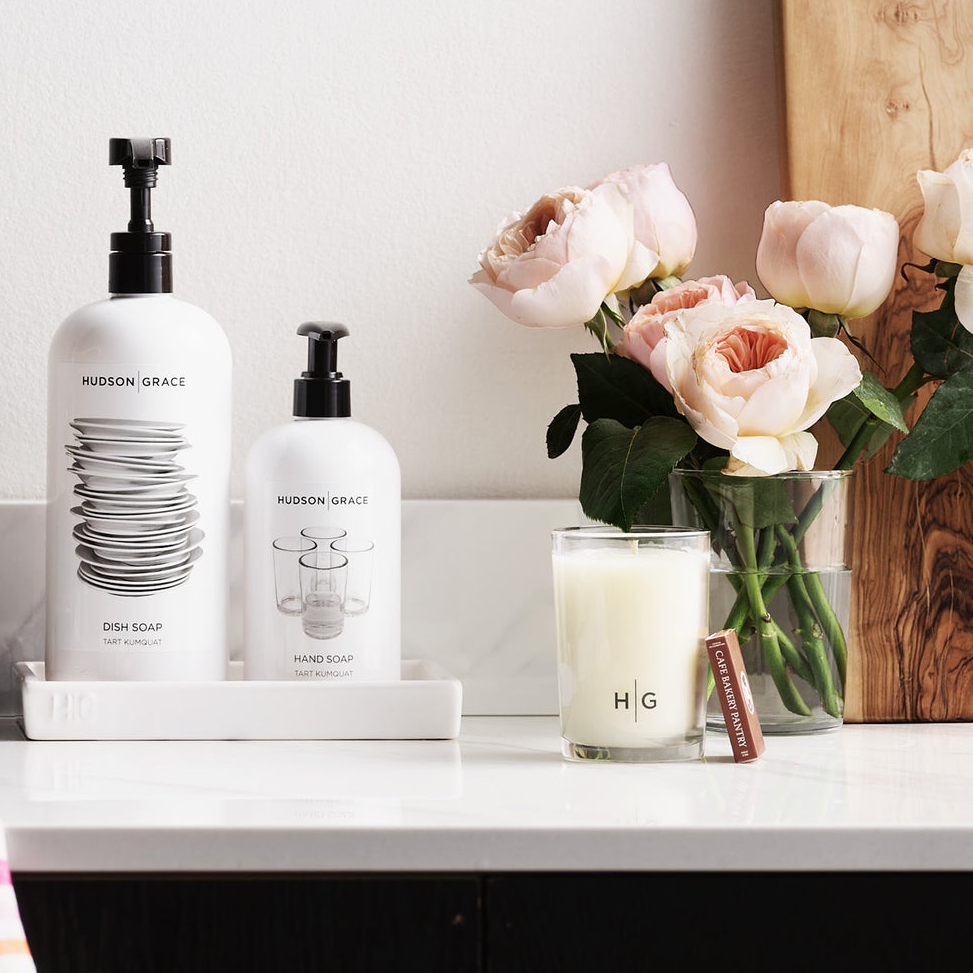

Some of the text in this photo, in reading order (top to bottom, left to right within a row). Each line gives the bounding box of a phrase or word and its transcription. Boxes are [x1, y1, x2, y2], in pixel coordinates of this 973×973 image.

[82, 376, 186, 388] HUDSON GRACE
[277, 495, 369, 506] HUDSON GRACE
[103, 622, 163, 632] DISH SOAP
[123, 638, 162, 646] KUMQUAT
[294, 654, 354, 664] HAND SOAP
[714, 650, 729, 676] CAFE
[294, 669, 354, 678] TART KUMQUAT
[721, 675, 738, 711] BAKERY
[730, 711, 748, 748] PANTRY
